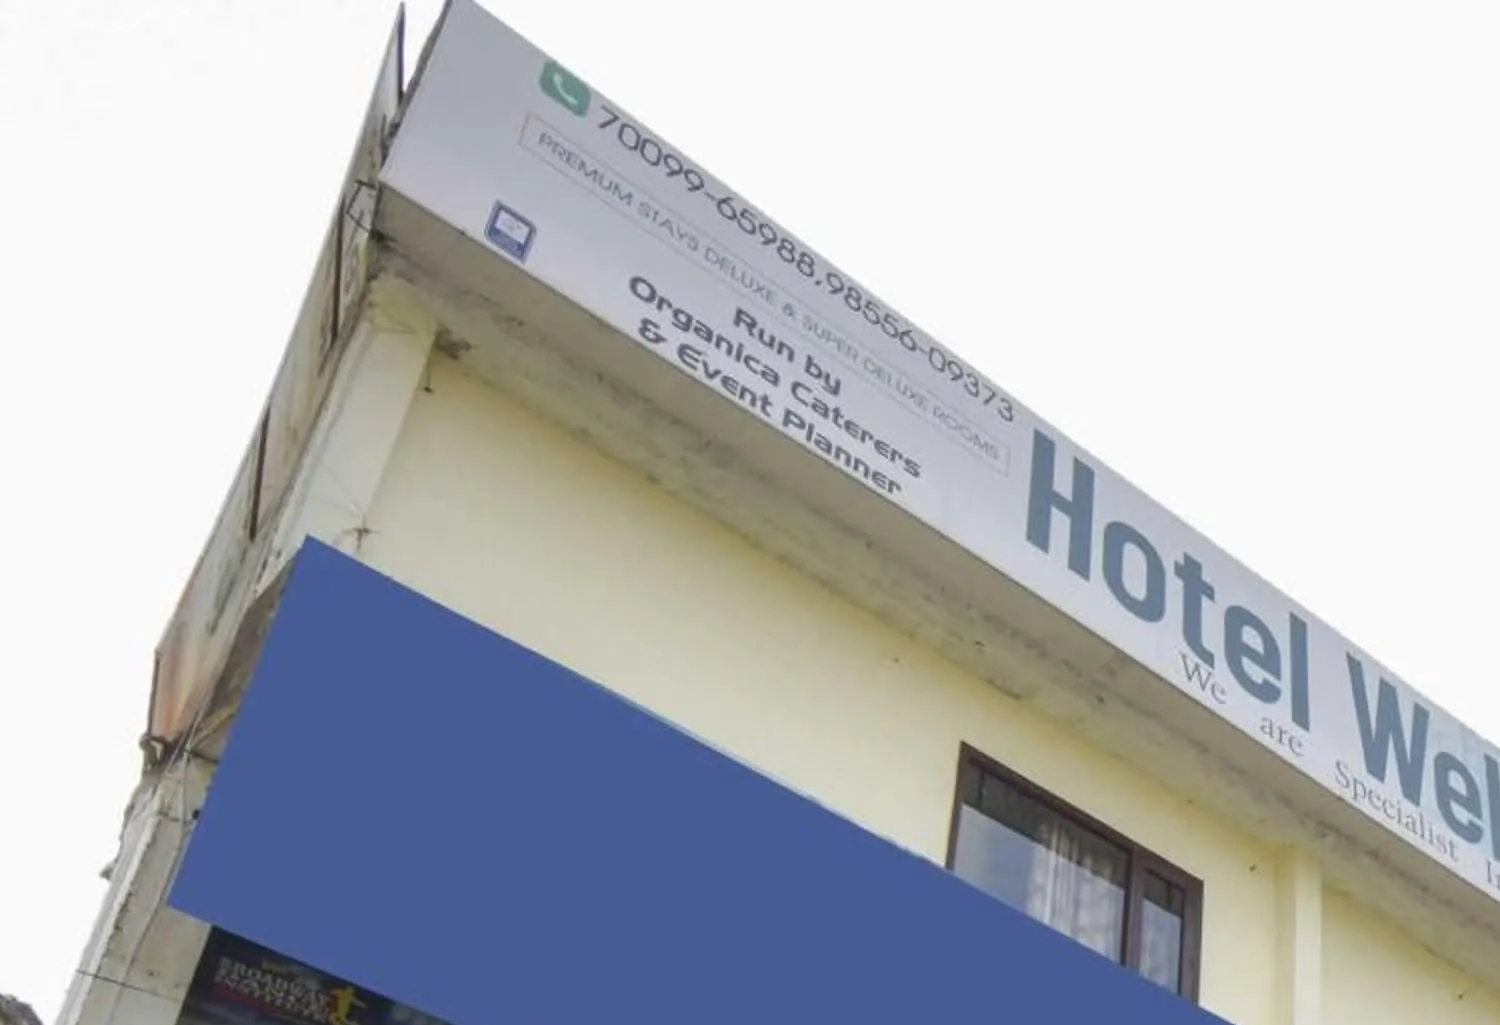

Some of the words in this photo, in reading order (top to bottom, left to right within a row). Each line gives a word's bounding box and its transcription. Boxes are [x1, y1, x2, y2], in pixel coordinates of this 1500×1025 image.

[629, 275, 781, 388] Organica
[790, 381, 922, 479] Caterers
[637, 317, 668, 345] &
[676, 343, 775, 417] Event
[782, 408, 901, 493] Planner
[734, 307, 795, 363] Run
[804, 353, 842, 397] by
[1026, 428, 1311, 734] Hotel
[1176, 652, 1228, 705] We
[1260, 715, 1306, 758] are
[1334, 759, 1459, 863] Specialist
